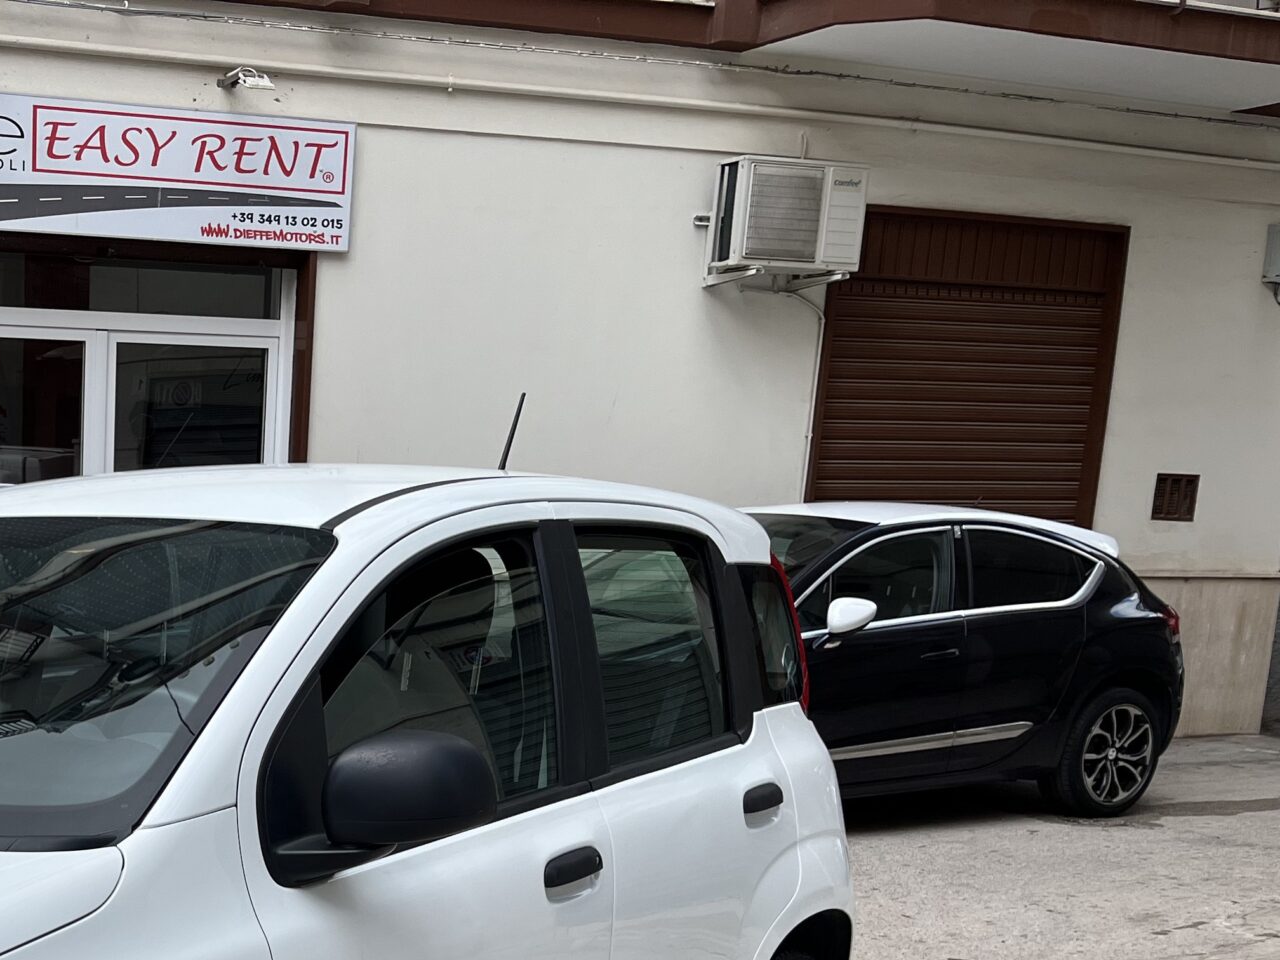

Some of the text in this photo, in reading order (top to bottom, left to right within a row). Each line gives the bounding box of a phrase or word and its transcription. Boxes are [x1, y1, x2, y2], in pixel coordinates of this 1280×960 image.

[42, 120, 177, 167] EASY
[191, 134, 339, 179] RENT
[231, 213, 343, 229] +39 349 13 02 015
